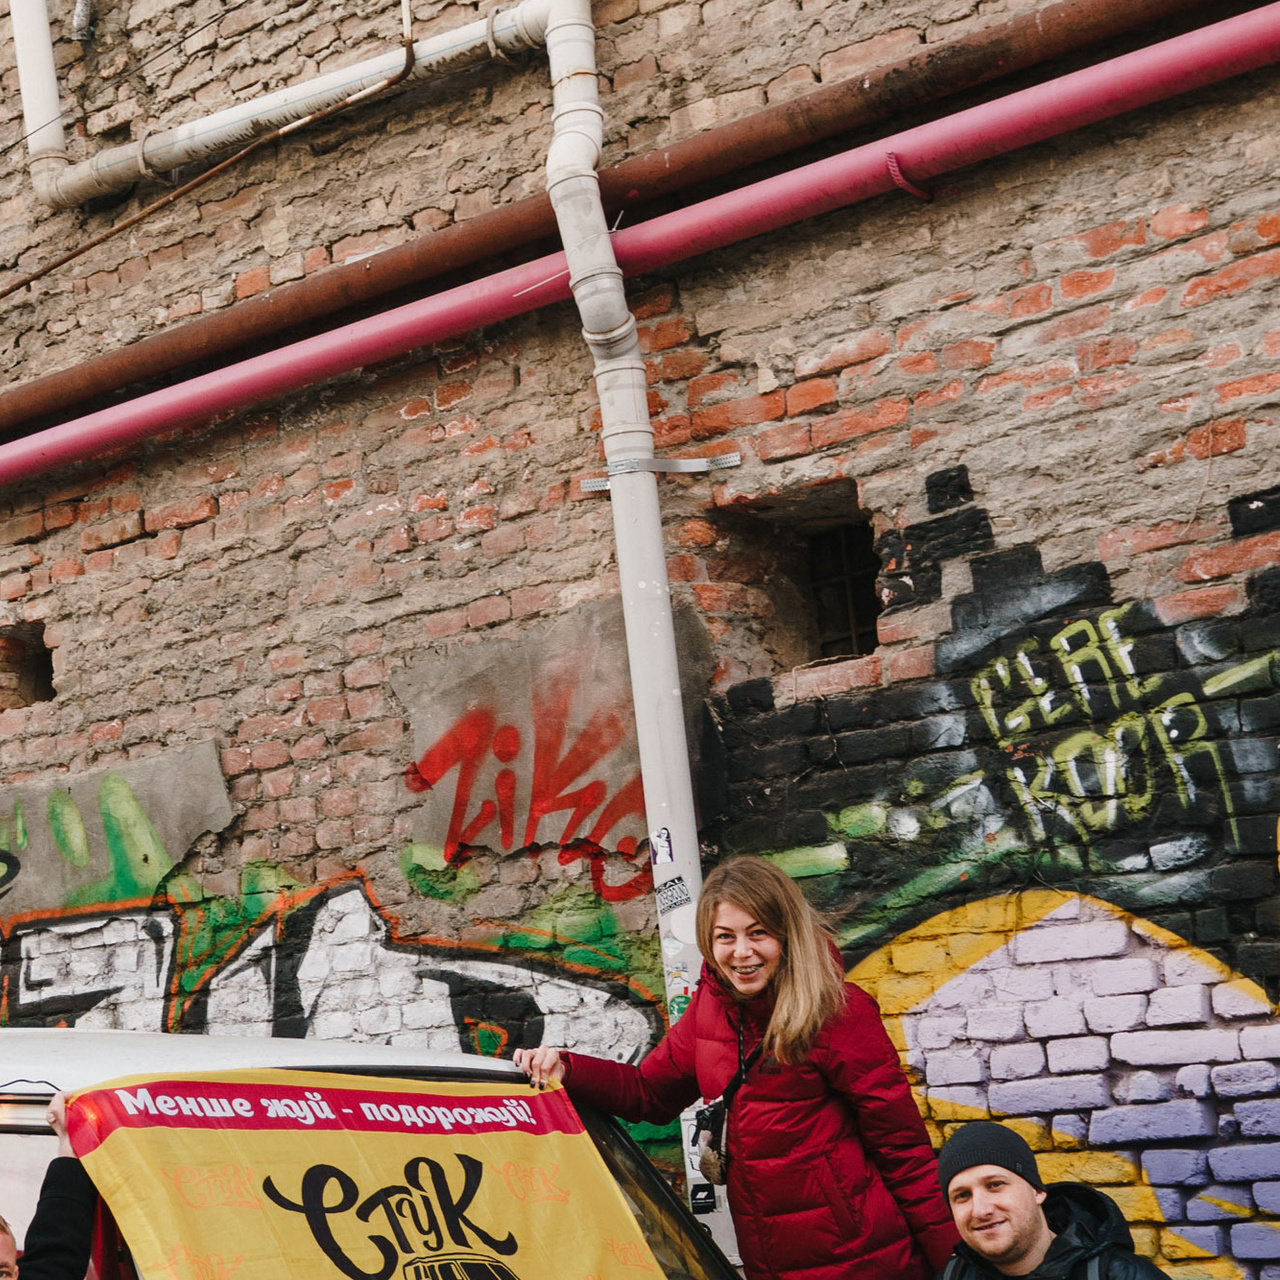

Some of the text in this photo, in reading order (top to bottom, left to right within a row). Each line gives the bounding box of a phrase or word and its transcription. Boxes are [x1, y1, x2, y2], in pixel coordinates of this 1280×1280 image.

[114, 1088, 252, 1118] Менше
[261, 1092, 336, 1125] жуй
[359, 1099, 538, 1130] подорожуй!
